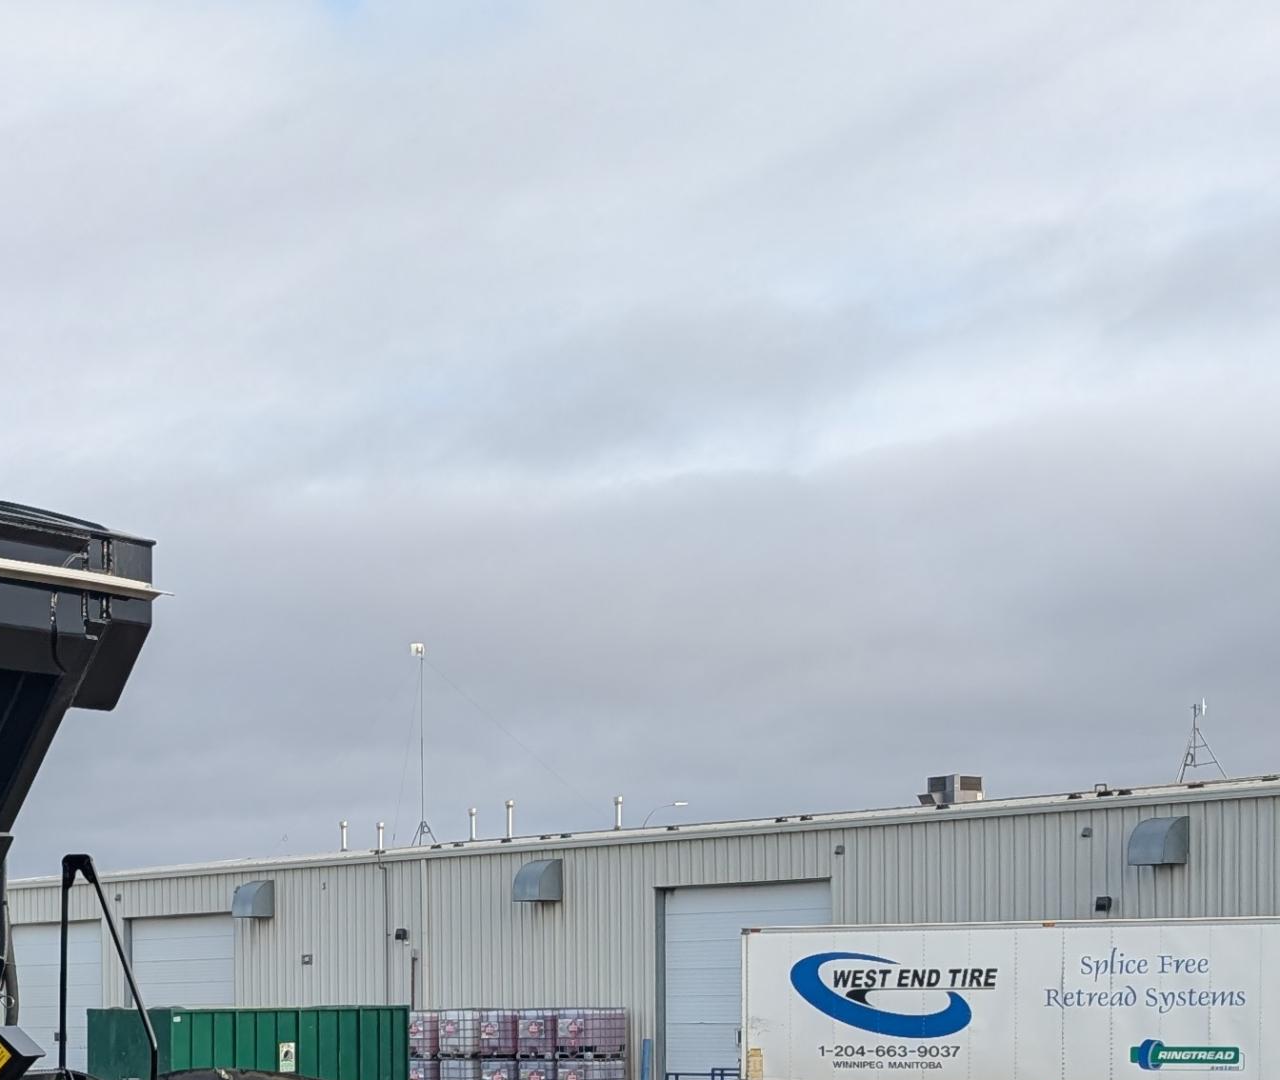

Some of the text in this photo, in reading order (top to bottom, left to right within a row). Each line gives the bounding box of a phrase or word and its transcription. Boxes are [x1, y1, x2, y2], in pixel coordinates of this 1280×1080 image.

[1080, 948, 1209, 982] Splice Free
[833, 968, 998, 988] WEST END TIRE
[1044, 986, 1246, 1014] Retread Systems
[818, 1045, 961, 1058] 1-204-663-9037
[1157, 1050, 1236, 1061] RINGTREAD
[833, 1060, 943, 1070] WINNIPEG MANITOBA
